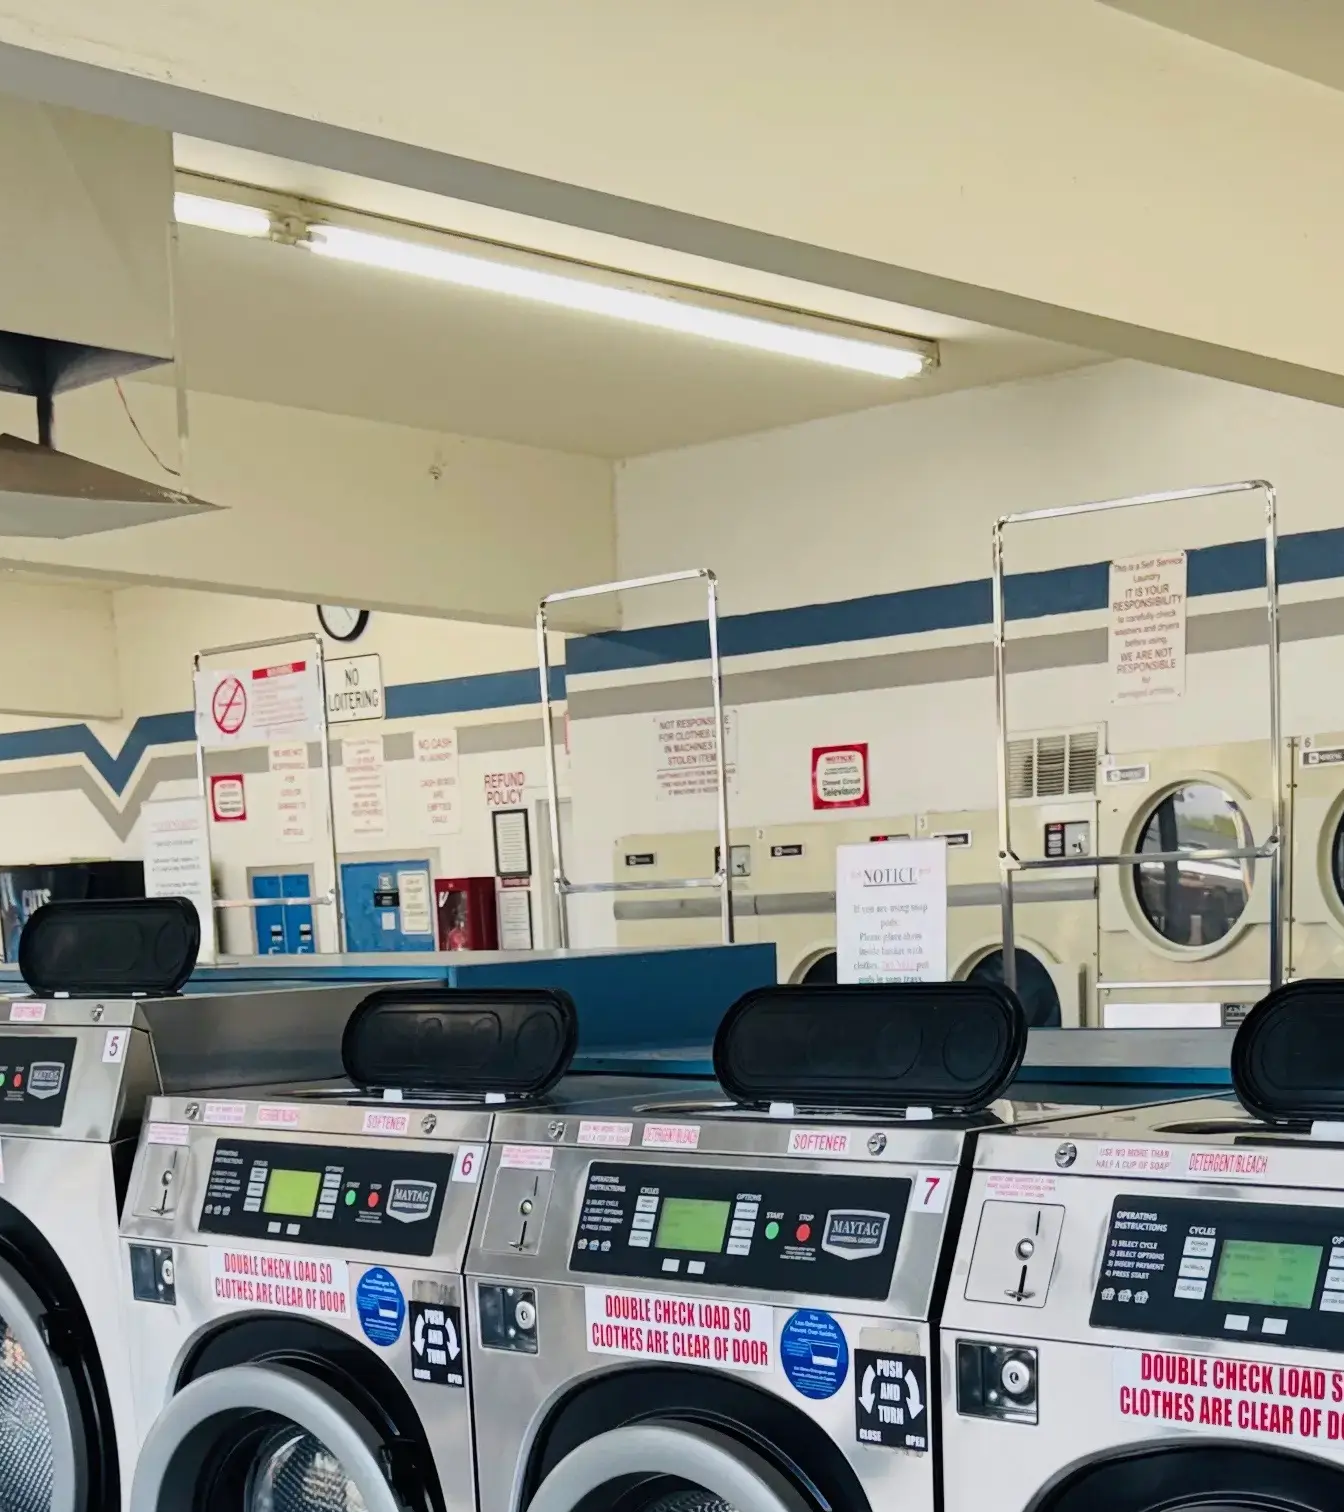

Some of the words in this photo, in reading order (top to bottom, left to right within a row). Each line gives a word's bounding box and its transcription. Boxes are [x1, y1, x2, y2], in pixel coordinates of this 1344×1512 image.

[345, 668, 359, 688] NO
[328, 689, 378, 712] LOITERING
[484, 772, 525, 789] REFUND
[487, 789, 524, 805] POLICY
[109, 1036, 119, 1056] 5
[793, 1134, 847, 1151] SOFTENER
[461, 1152, 474, 1176] 6
[394, 1188, 429, 1202] MAYTAG
[924, 1178, 940, 1205] 7
[1117, 1211, 1157, 1221] OPERATING
[832, 1220, 880, 1236] MAYTAG
[1115, 1221, 1168, 1232] INSTRUCTIONS
[1189, 1226, 1216, 1235] CYCLES
[224, 1253, 258, 1276] DOUBLE
[260, 1258, 291, 1279] CHECK
[294, 1261, 317, 1281] LOAD
[319, 1265, 332, 1284] SO
[215, 1277, 254, 1301] CLOTHES
[256, 1283, 273, 1304] ARE
[275, 1286, 303, 1307] CLEAR
[306, 1290, 317, 1309] OF
[320, 1292, 346, 1313] DOOR
[606, 1295, 651, 1322] DOUBLE
[655, 1299, 695, 1327] CHECK
[699, 1304, 730, 1330] LOAD
[734, 1307, 750, 1333] SO
[592, 1323, 643, 1351] CLOTHES
[647, 1330, 669, 1354] ARE
[672, 1332, 710, 1359] CLEAR
[715, 1337, 729, 1361] OF
[733, 1339, 768, 1366] DOOR
[876, 1359, 902, 1378] PUSH
[1141, 1352, 1207, 1388] DOUBLE
[1213, 1360, 1274, 1394] CHECK
[1279, 1367, 1326, 1400] LOAD
[880, 1383, 900, 1401] AND
[878, 1405, 903, 1425] TURN
[1120, 1386, 1194, 1422] CLOTHES
[1199, 1396, 1232, 1428] ARE
[1238, 1400, 1294, 1434] CLEAR
[1300, 1407, 1322, 1438] OF
[860, 1429, 881, 1442] CLOSE
[906, 1435, 925, 1448] OPEN
